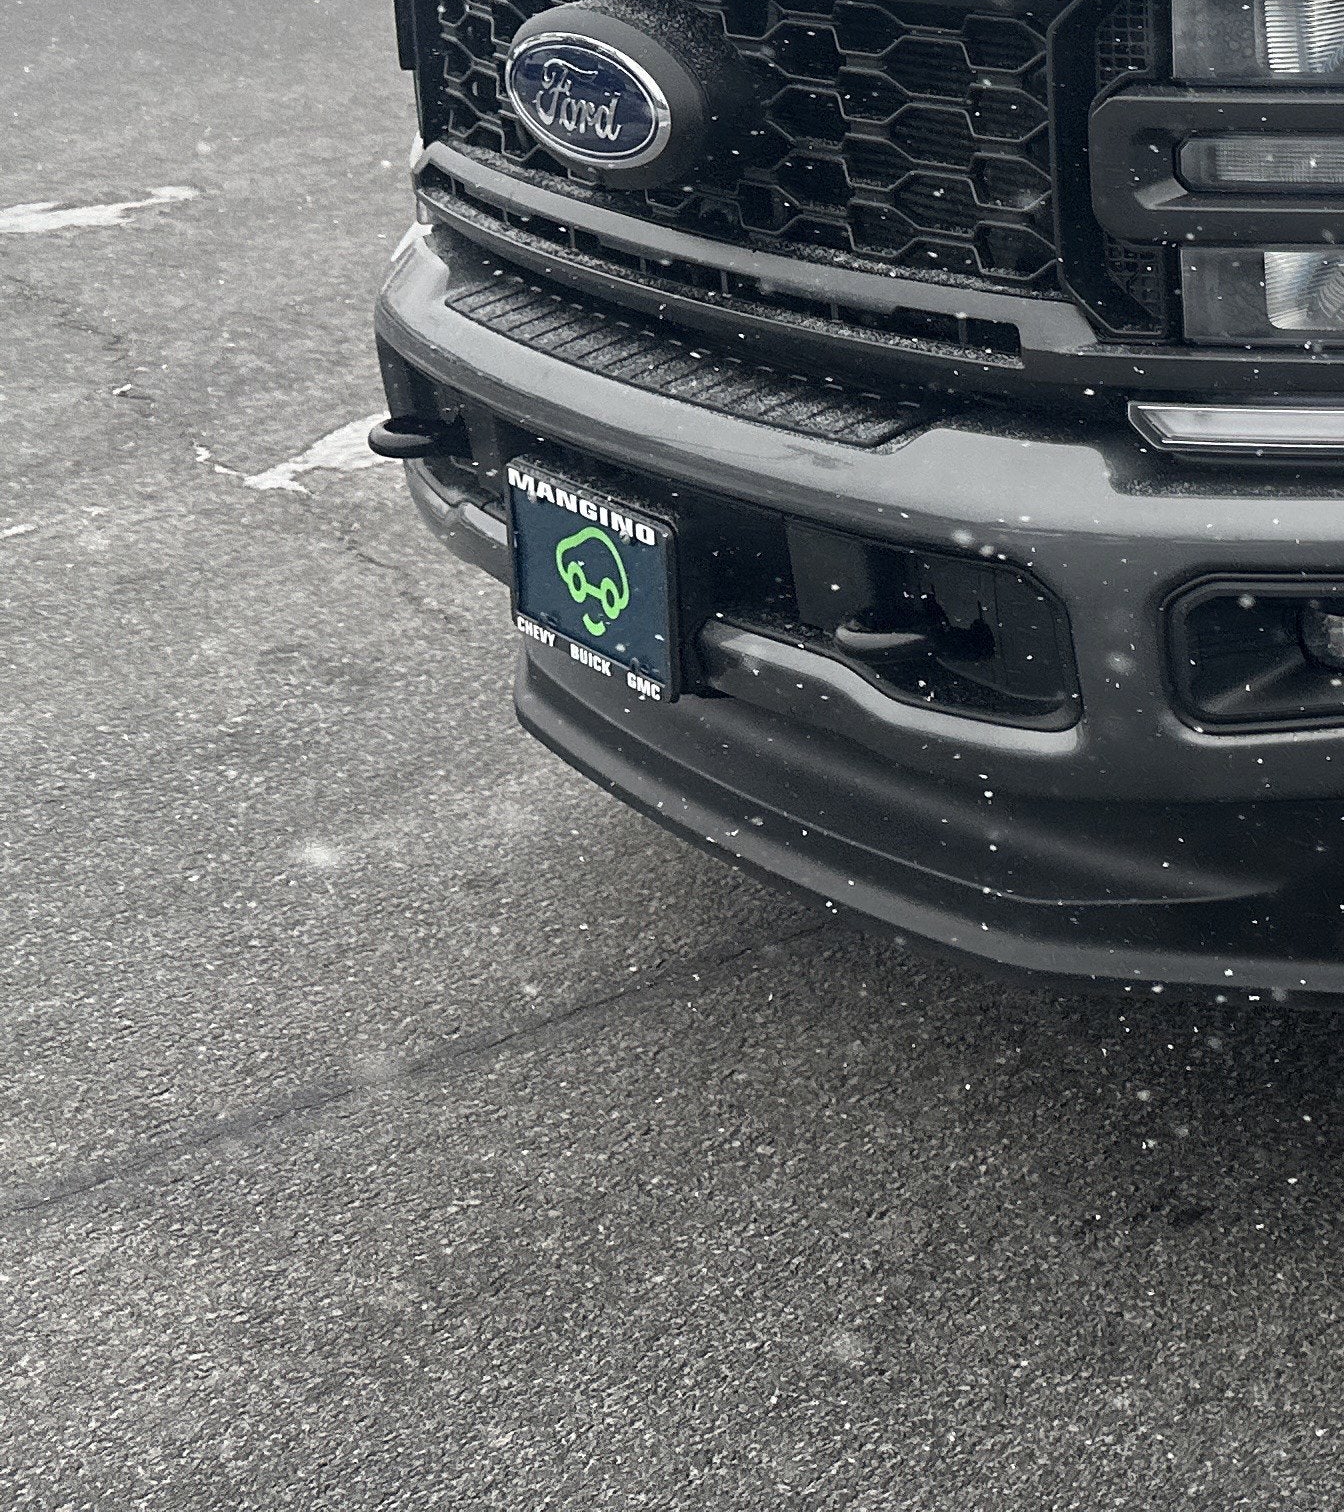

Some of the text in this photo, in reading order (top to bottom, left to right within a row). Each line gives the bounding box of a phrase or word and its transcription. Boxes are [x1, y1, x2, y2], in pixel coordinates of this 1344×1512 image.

[535, 58, 621, 141] Ford
[508, 468, 656, 546] MANGINO
[517, 616, 661, 700] CHEVY BUICK GMC
